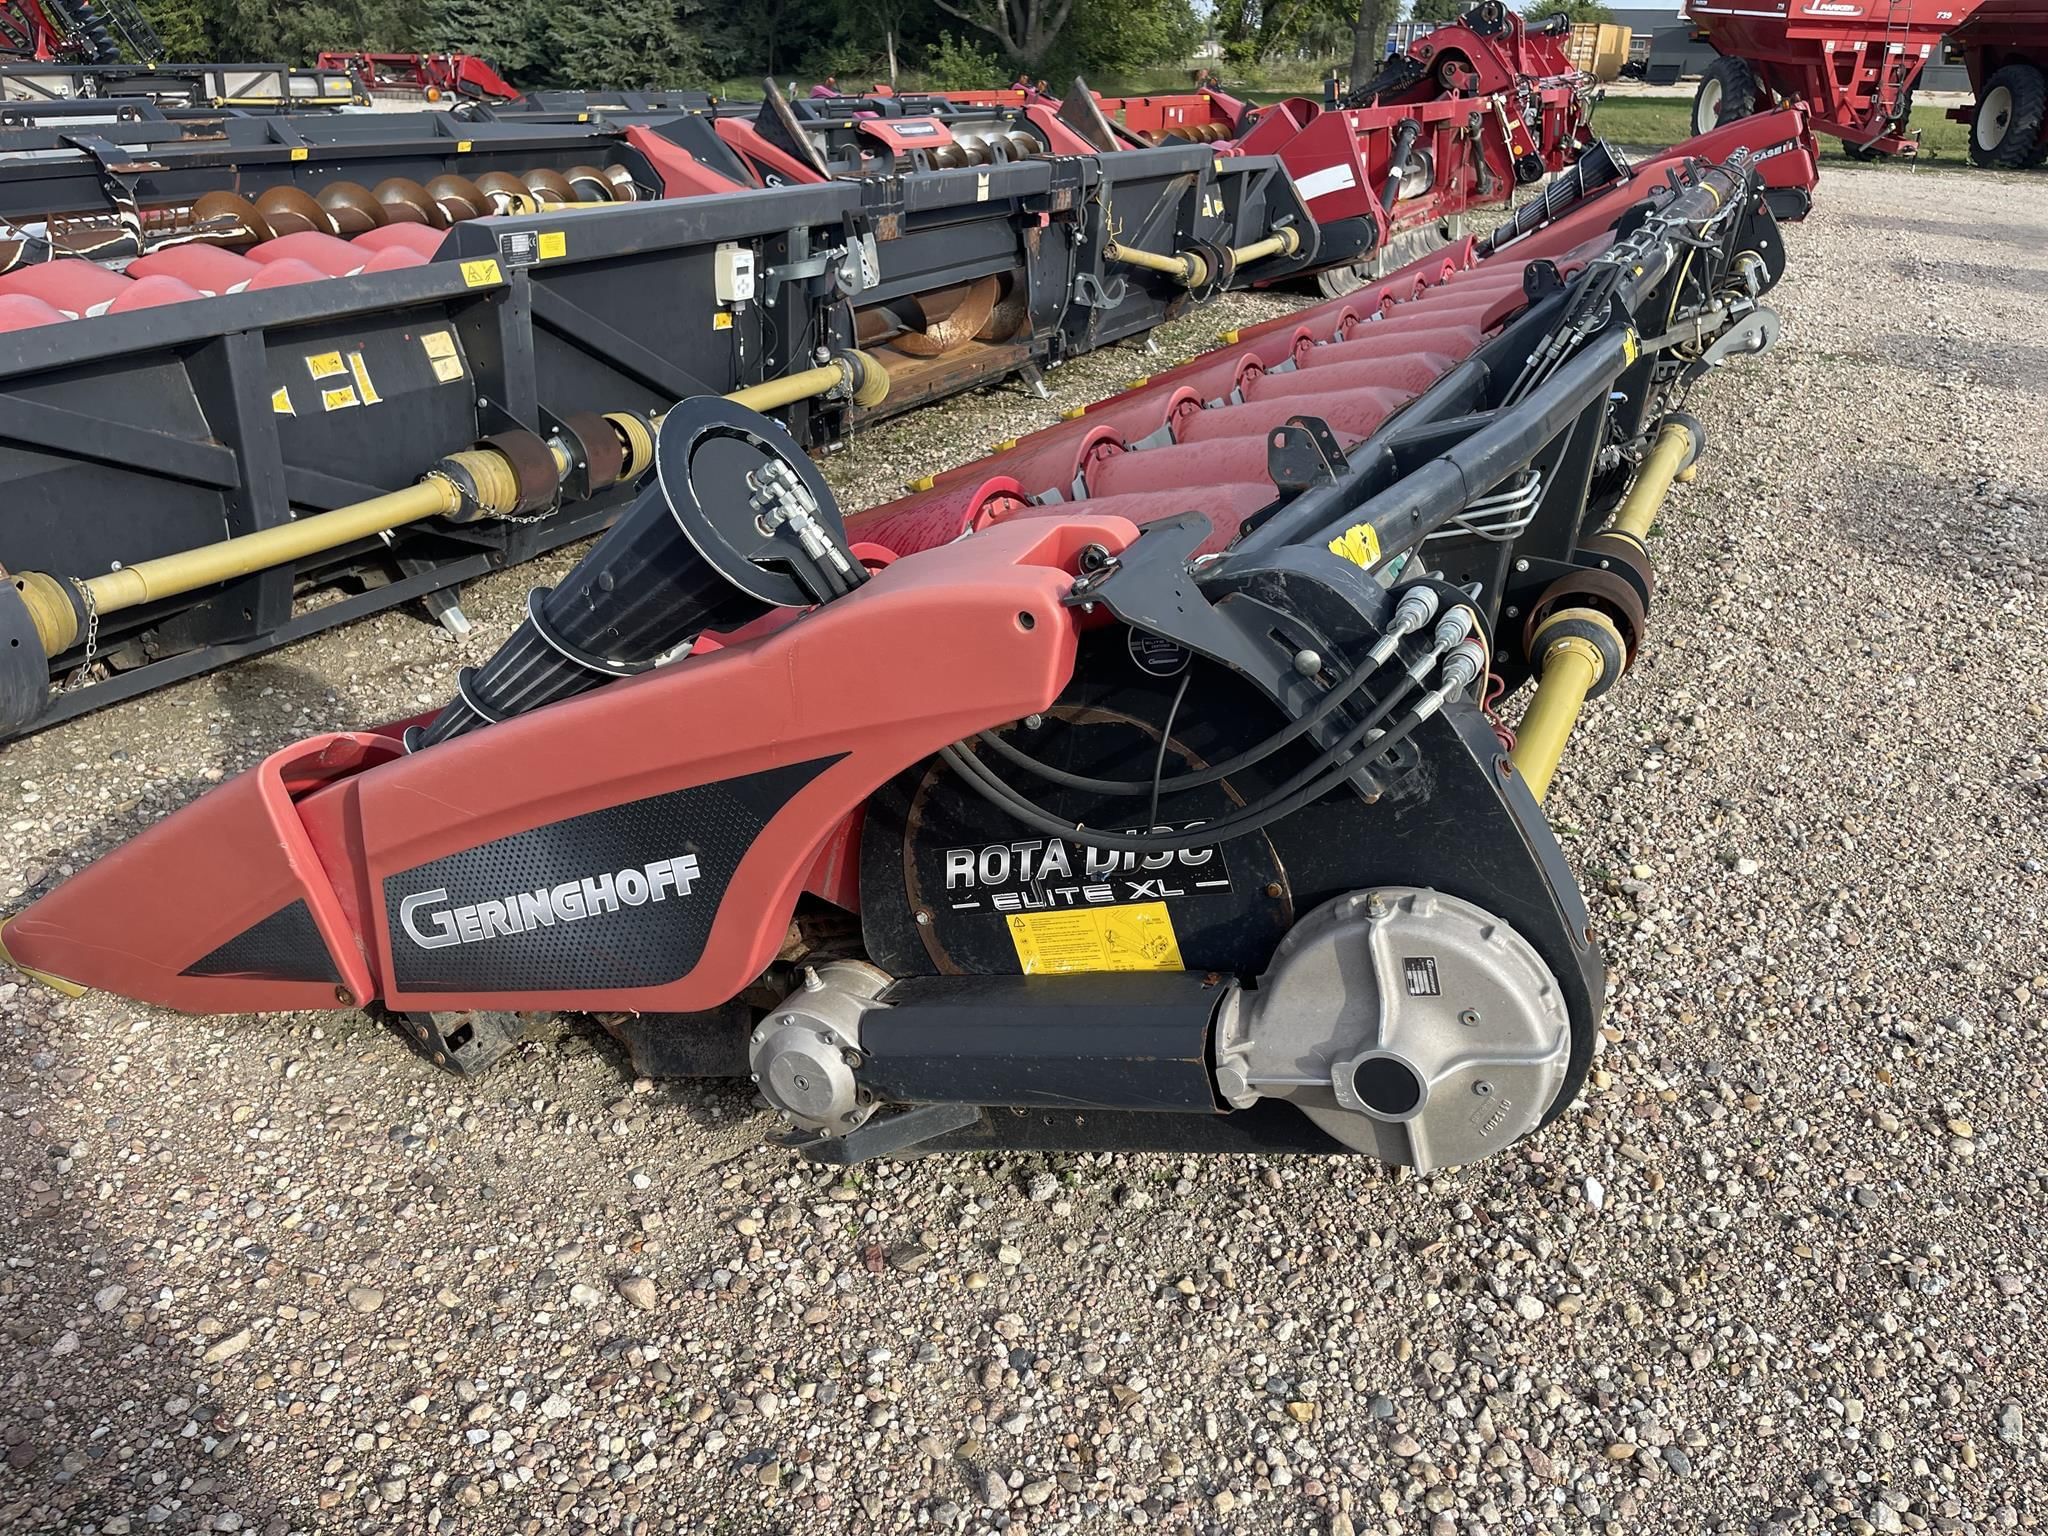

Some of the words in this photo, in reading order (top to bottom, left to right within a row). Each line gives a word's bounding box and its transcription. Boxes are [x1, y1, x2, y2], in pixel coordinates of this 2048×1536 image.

[1819, 3, 1856, 12] PARKER
[1936, 11, 1953, 20] 739
[1752, 146, 1782, 162] CASE
[945, 838, 1072, 889] ROTA
[399, 853, 701, 950] GERINGHOFF
[991, 883, 1116, 911] ELITE
[1124, 879, 1185, 900] XL
